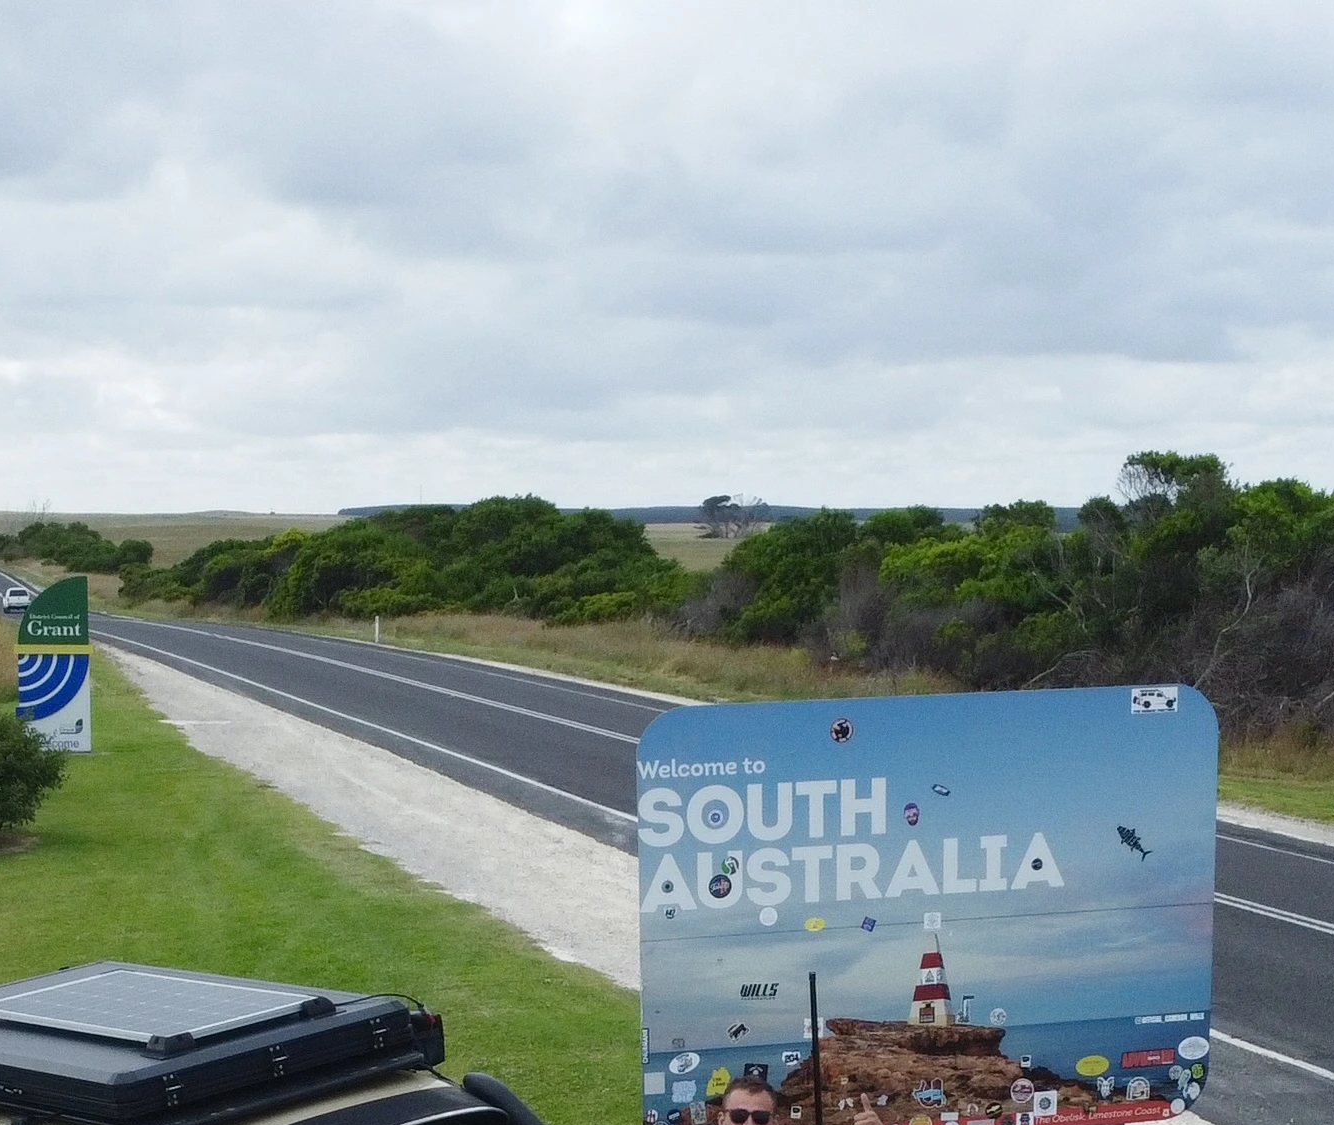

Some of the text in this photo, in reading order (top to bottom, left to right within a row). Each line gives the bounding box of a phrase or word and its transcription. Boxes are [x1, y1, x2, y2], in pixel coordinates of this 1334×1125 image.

[27, 620, 81, 637] Grant
[637, 758, 765, 779] Welcome to
[638, 777, 886, 847] SOUTH
[640, 832, 1065, 913] AUSTRALIA
[740, 983, 779, 997] WILLS
[1035, 1116, 1051, 1125] The
[1088, 1110, 1133, 1120] Limestone
[1135, 1106, 1160, 1116] Coast
